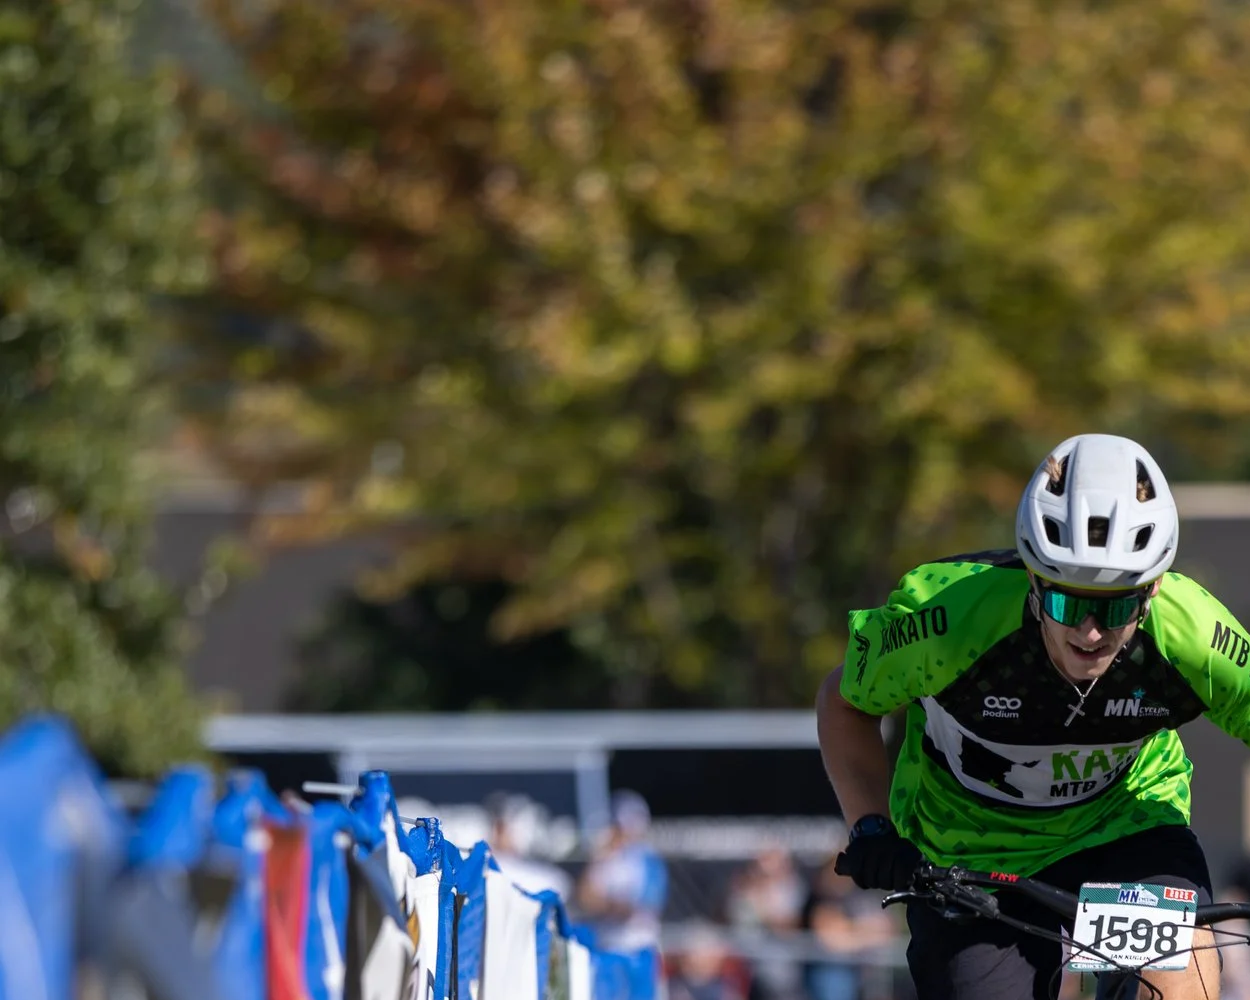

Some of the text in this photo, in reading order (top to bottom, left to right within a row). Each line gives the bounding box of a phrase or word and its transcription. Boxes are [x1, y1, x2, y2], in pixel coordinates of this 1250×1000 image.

[1210, 620, 1250, 668] MTB
[982, 709, 1019, 719] podium
[1104, 699, 1140, 717] MN
[1052, 742, 1140, 781] KAT
[1050, 780, 1097, 798] MTB
[1118, 889, 1140, 903] MN
[1088, 914, 1179, 957] 1598
